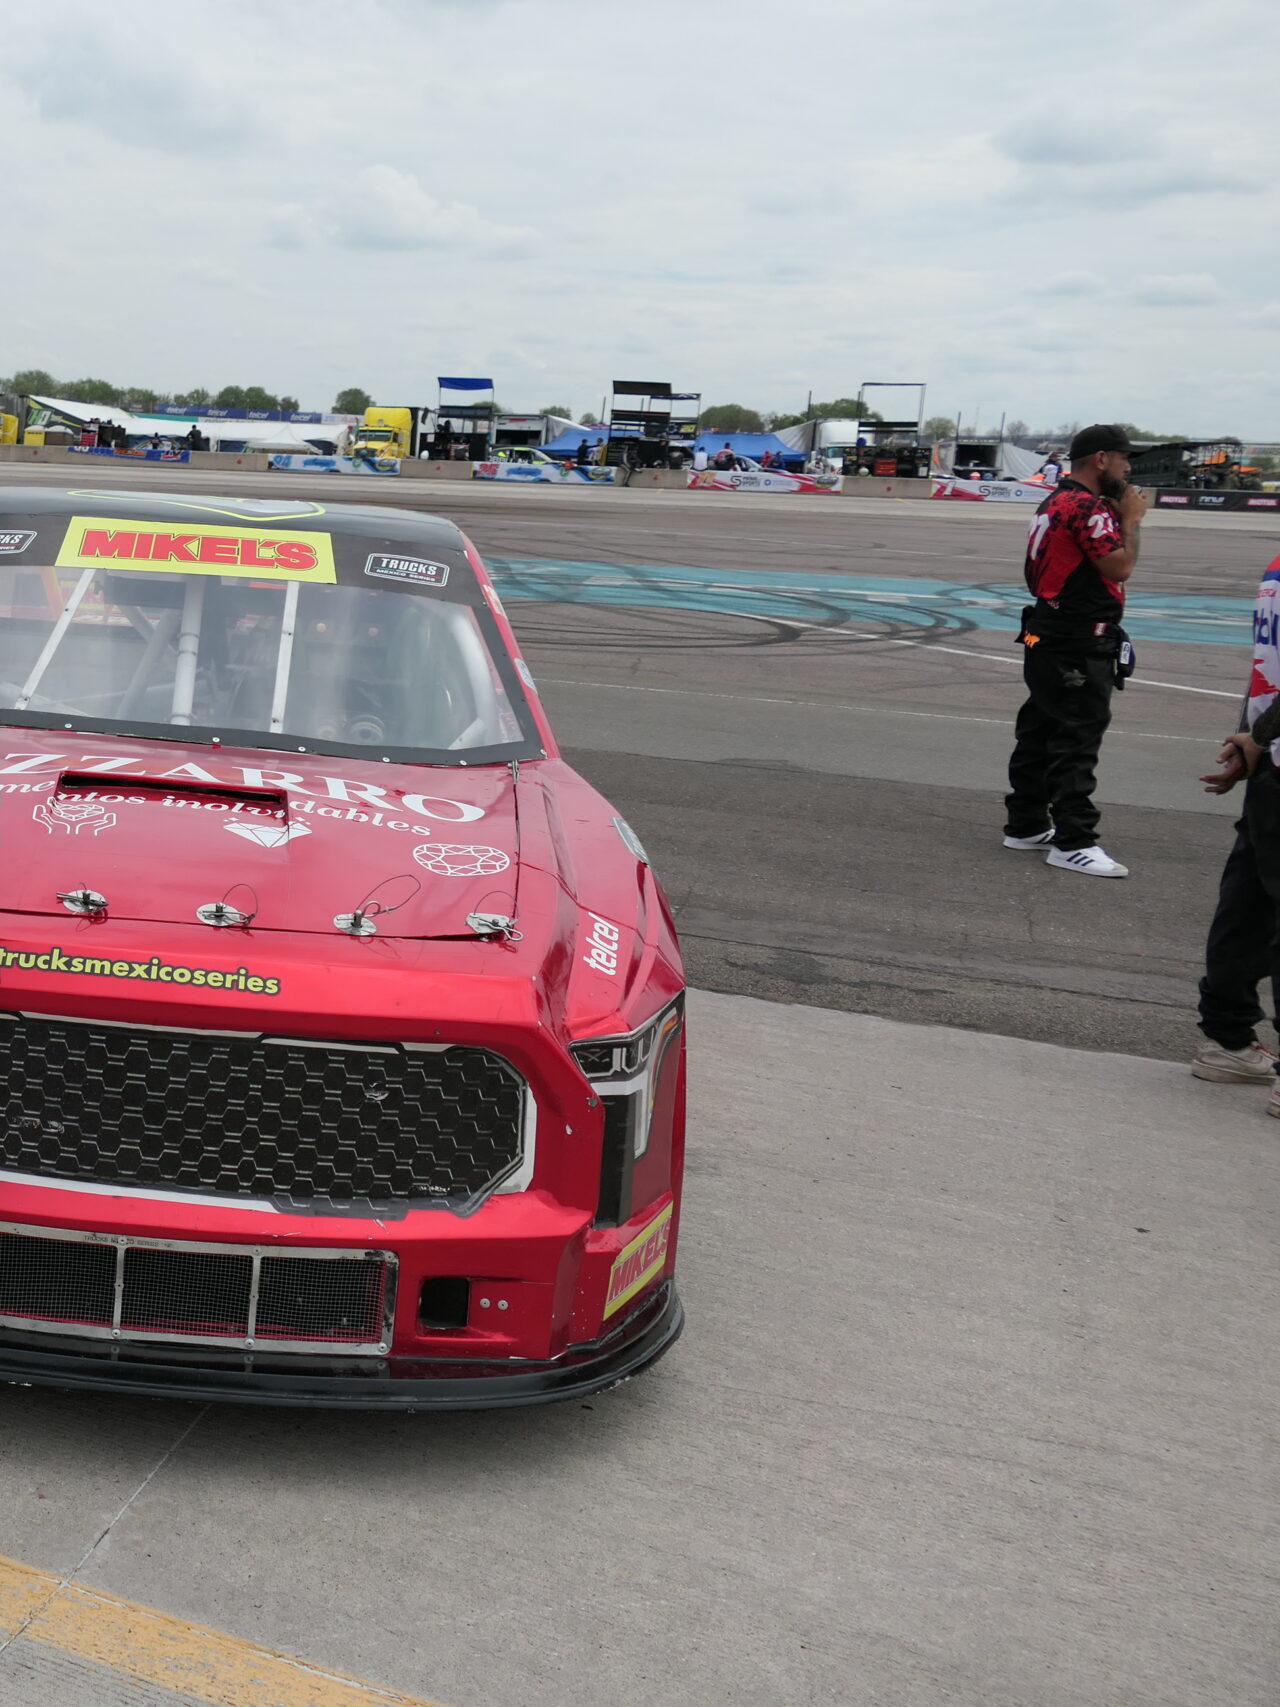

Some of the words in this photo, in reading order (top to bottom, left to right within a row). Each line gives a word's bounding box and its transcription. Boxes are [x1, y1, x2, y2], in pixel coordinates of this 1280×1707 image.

[79, 529, 319, 571] MIKEL'S
[380, 558, 438, 575] TRUCKS
[584, 912, 619, 976] telcel
